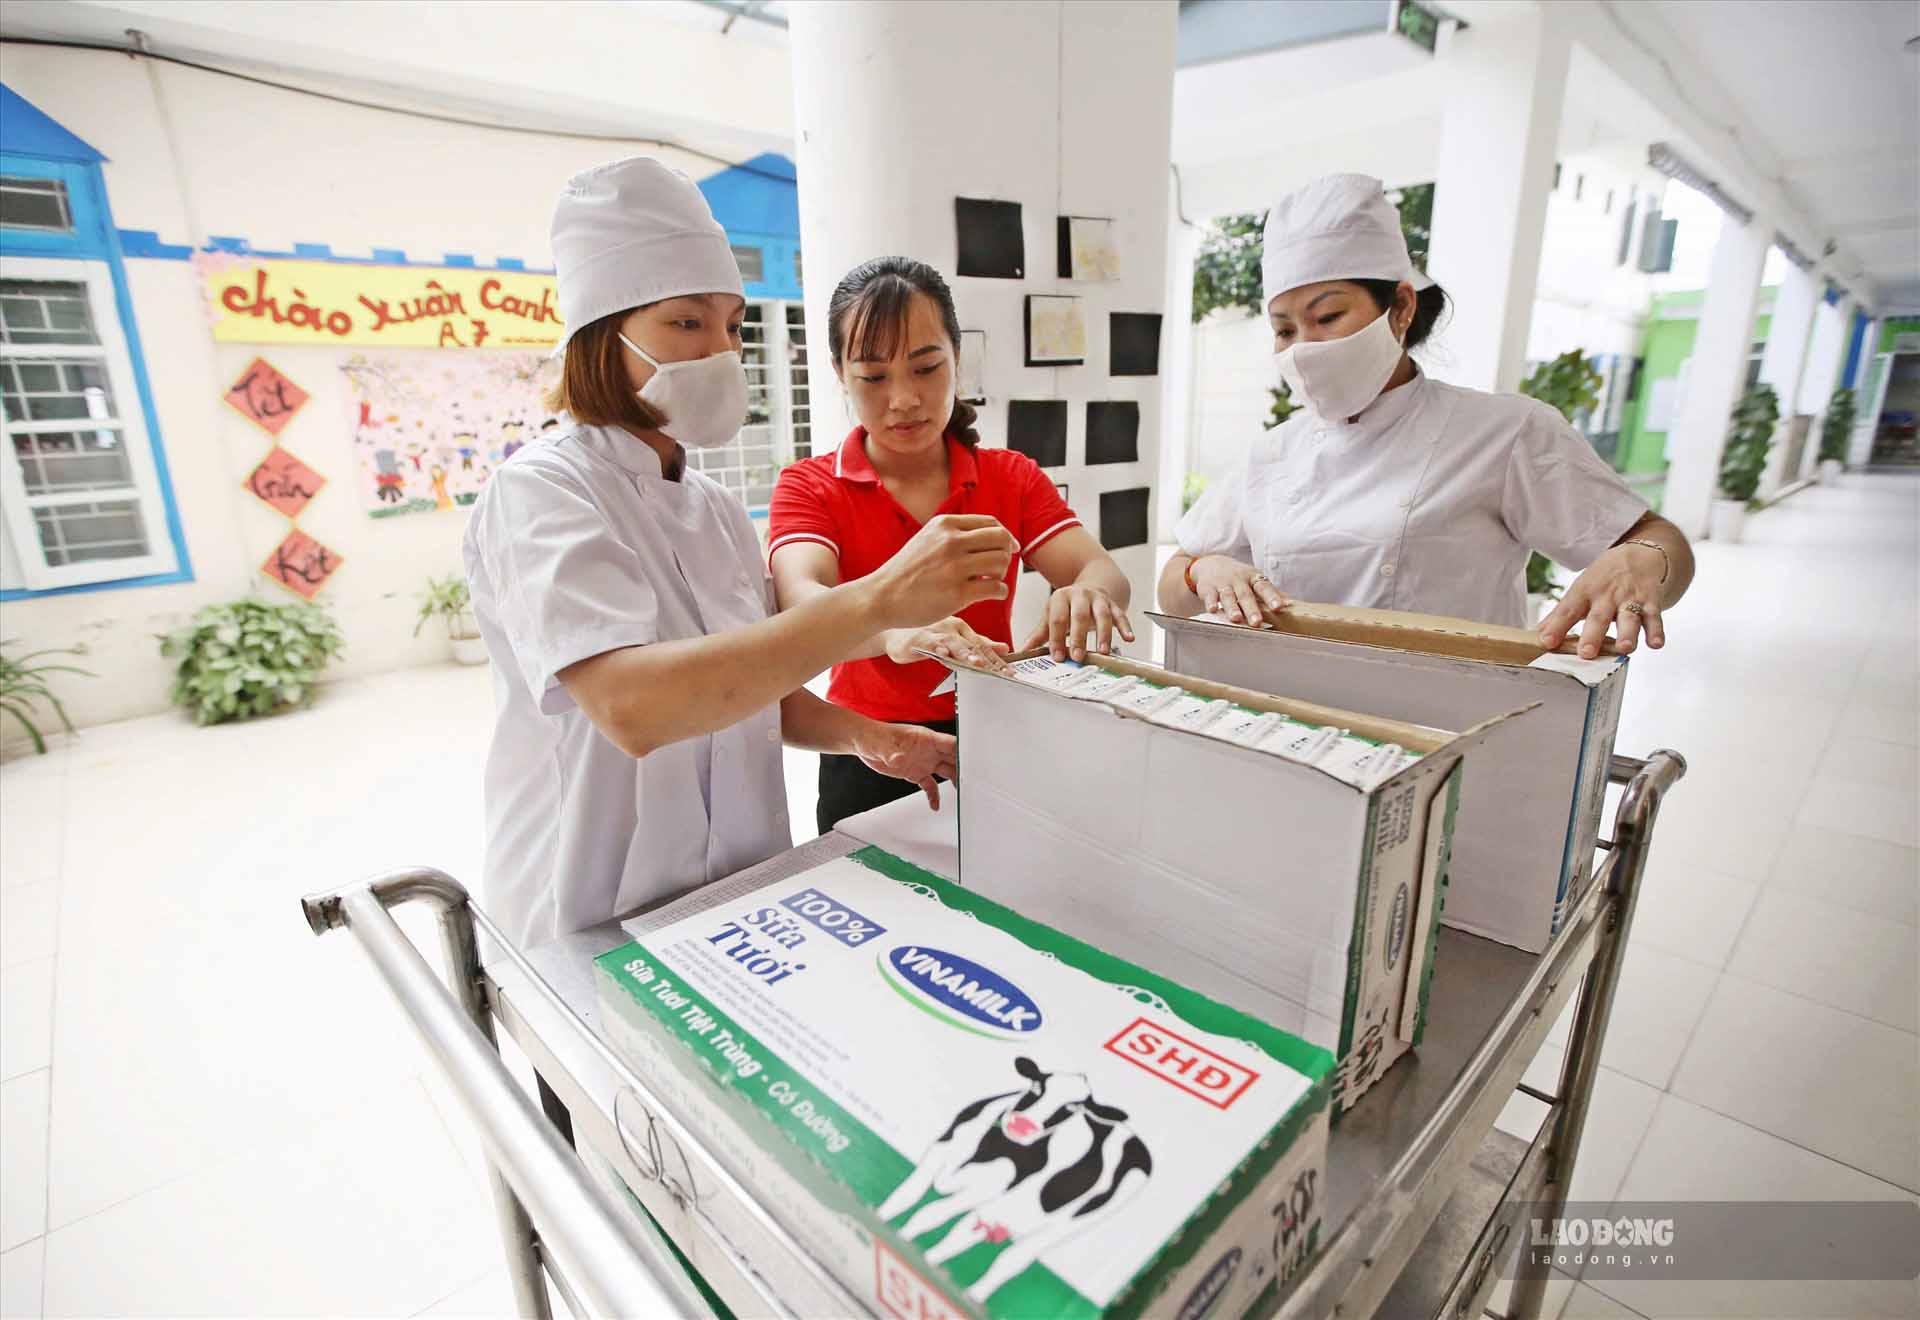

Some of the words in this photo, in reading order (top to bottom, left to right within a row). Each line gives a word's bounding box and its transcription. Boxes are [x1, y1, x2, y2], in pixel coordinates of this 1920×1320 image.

[480, 279, 565, 325] Canh
[742, 907, 807, 950] Sữa
[790, 892, 877, 943] 100%
[705, 921, 807, 987] Tươi
[899, 947, 1037, 1031] VINAMILK
[709, 1028, 763, 1079] Trùng
[768, 1080, 800, 1106] Có
[1127, 1033, 1234, 1091] SHĐ
